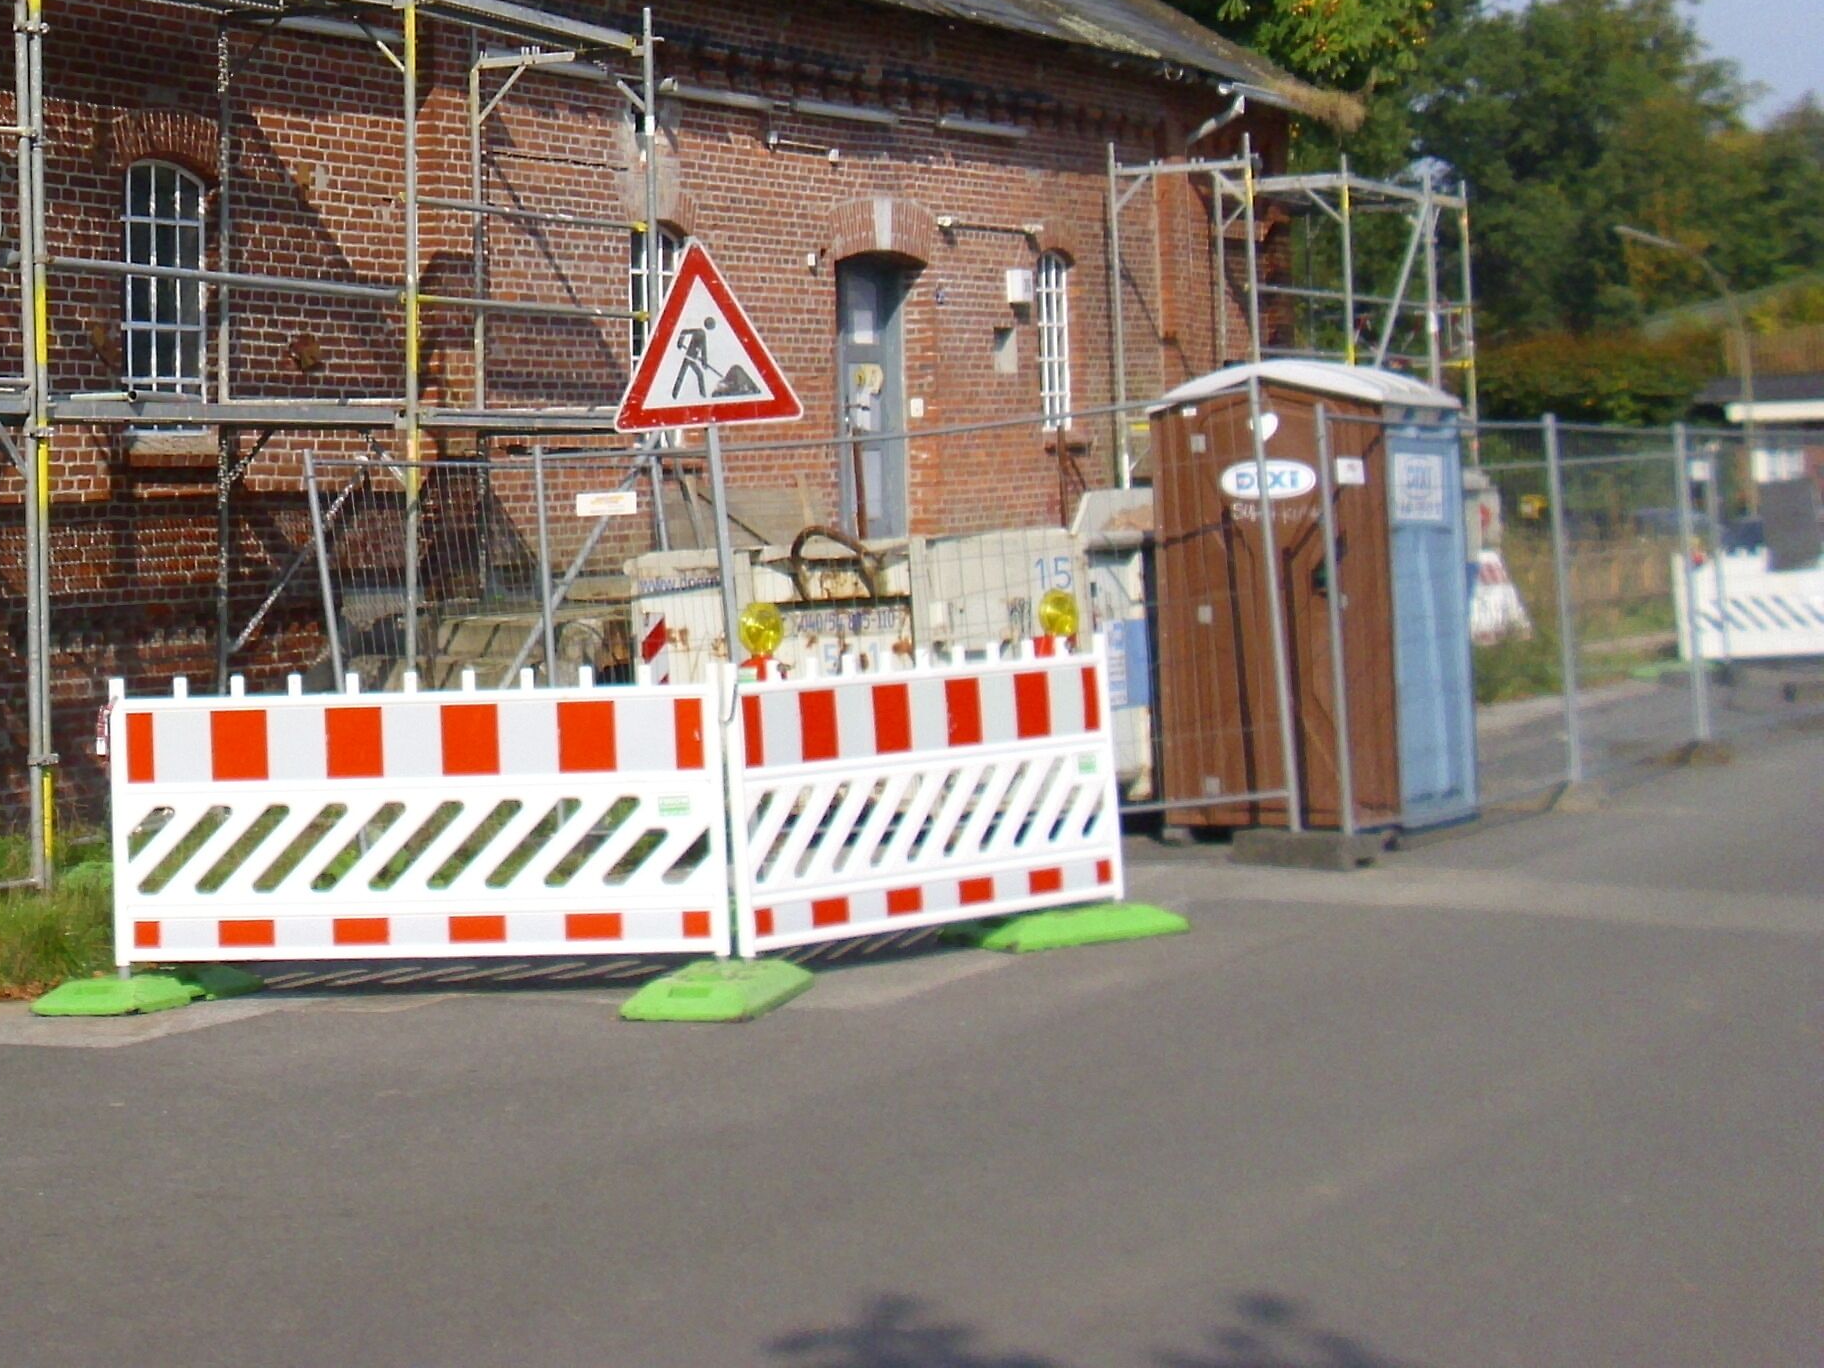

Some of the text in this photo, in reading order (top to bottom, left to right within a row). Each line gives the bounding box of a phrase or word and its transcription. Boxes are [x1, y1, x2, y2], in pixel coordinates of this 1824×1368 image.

[1236, 471, 1299, 490] DXI
[1034, 556, 1073, 590] 15
[848, 609, 895, 632] 85-110
